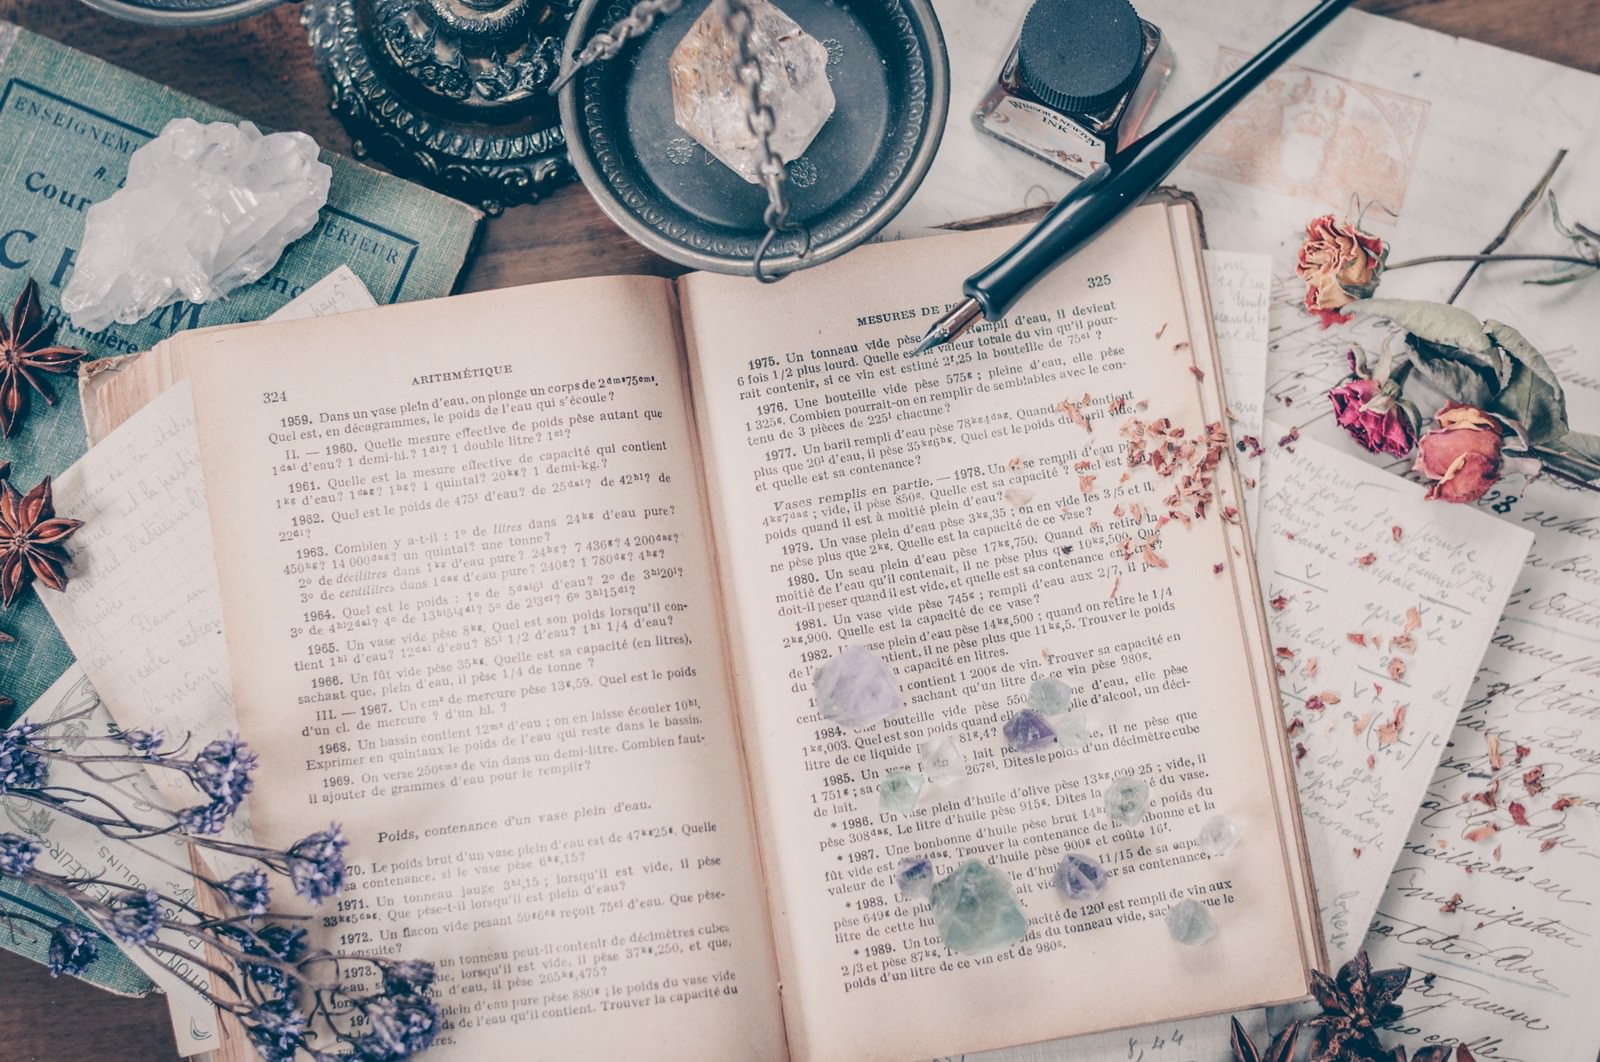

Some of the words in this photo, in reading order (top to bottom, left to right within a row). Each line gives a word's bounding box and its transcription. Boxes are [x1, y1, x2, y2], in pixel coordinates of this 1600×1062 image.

[1042, 116, 1069, 134] INK
[25, 171, 92, 213] Cour
[323, 219, 399, 265] ERIEUR
[1087, 274, 1112, 289] 325
[856, 309, 916, 326] MESURES
[920, 305, 940, 316] DE
[411, 364, 512, 385] ARITHMÉTIQUE
[739, 387, 761, 400] rait
[765, 378, 819, 395] contenir,
[823, 374, 833, 385] si
[838, 374, 850, 383] ce
[855, 368, 874, 380] vin
[879, 365, 896, 377] est
[900, 357, 938, 373] estimé
[976, 350, 988, 360] la
[992, 341, 1043, 358] bouteille
[1048, 337, 1062, 348] de
[757, 401, 788, 415] 1976.
[794, 398, 818, 409] Une
[824, 387, 876, 404] bouteille
[882, 382, 907, 395] vide
[914, 378, 939, 392] pèse
[988, 364, 1022, 380] pleine
[1029, 357, 1066, 370] d'eau,
[1072, 351, 1093, 363] elle
[1100, 346, 1125, 360] pèse
[263, 391, 288, 404] 324
[280, 414, 312, 427] 1959.
[319, 412, 350, 423] Dans
[352, 410, 368, 419] un
[370, 406, 397, 417] vase
[399, 400, 429, 415] plein
[431, 397, 468, 408] d'eau,
[471, 395, 485, 403] on
[487, 389, 527, 404] plonge
[529, 387, 545, 396] un
[547, 382, 580, 397] corps
[581, 379, 598, 390] de
[268, 430, 296, 445] Quel
[299, 428, 322, 440] est,
[325, 428, 340, 436] en
[343, 416, 429, 434] décagrammes,
[432, 412, 444, 423] le
[448, 407, 480, 423] poids
[483, 404, 498, 415] de
[501, 402, 532, 413] l'eau
[535, 397, 555, 412] qui
[288, 480, 320, 493] 1961.
[327, 474, 366, 490] Quelle
[371, 471, 389, 483] est
[395, 469, 407, 480] la
[412, 463, 455, 478] mesure
[461, 456, 512, 471] effective
[518, 452, 532, 464] de
[539, 445, 590, 462] capacité
[596, 443, 615, 457] qui
[621, 440, 667, 452] contient
[755, 481, 768, 492] et
[772, 474, 808, 490] quelle
[811, 470, 829, 482] est
[832, 469, 845, 478] sa
[773, 498, 812, 511] Vases
[818, 487, 866, 504] remplis
[871, 486, 887, 495] en
[892, 477, 933, 495] partie.
[953, 465, 985, 480] 1978.
[987, 463, 1006, 474] Un
[777, 601, 815, 616] doit-il
[817, 597, 847, 612] peser
[850, 588, 887, 606] quand
[888, 587, 897, 598] il
[899, 584, 917, 596] est
[919, 580, 948, 592] vide,
[950, 576, 963, 588] et
[965, 570, 1000, 587] quelle
[1002, 566, 1020, 578] est
[1022, 564, 1035, 574] sa
[1037, 553, 1104, 571] contenance
[305, 756, 364, 771] Exprimer
[369, 754, 384, 763] en
[388, 746, 444, 763] quintaux
[448, 743, 459, 753] le
[464, 737, 497, 754] poids
[501, 735, 516, 746] de
[520, 732, 551, 744] l'eau
[556, 727, 576, 742] qui
[581, 724, 611, 736] reste
[615, 720, 644, 732] dans
[648, 717, 659, 728] le
[664, 714, 702, 727] bassin.
[377, 828, 418, 843] Poids,
[424, 821, 497, 837] contenance
[504, 815, 531, 826] d'un
[538, 811, 567, 822] vase
[573, 805, 606, 821] plein
[613, 801, 651, 813] d'eau.
[844, 975, 876, 992] poids
[879, 971, 907, 982] d'un
[909, 966, 936, 978] litre
[939, 960, 953, 971] de
[956, 960, 970, 969] ce
[996, 949, 1015, 962] est
[1017, 945, 1032, 956] de
